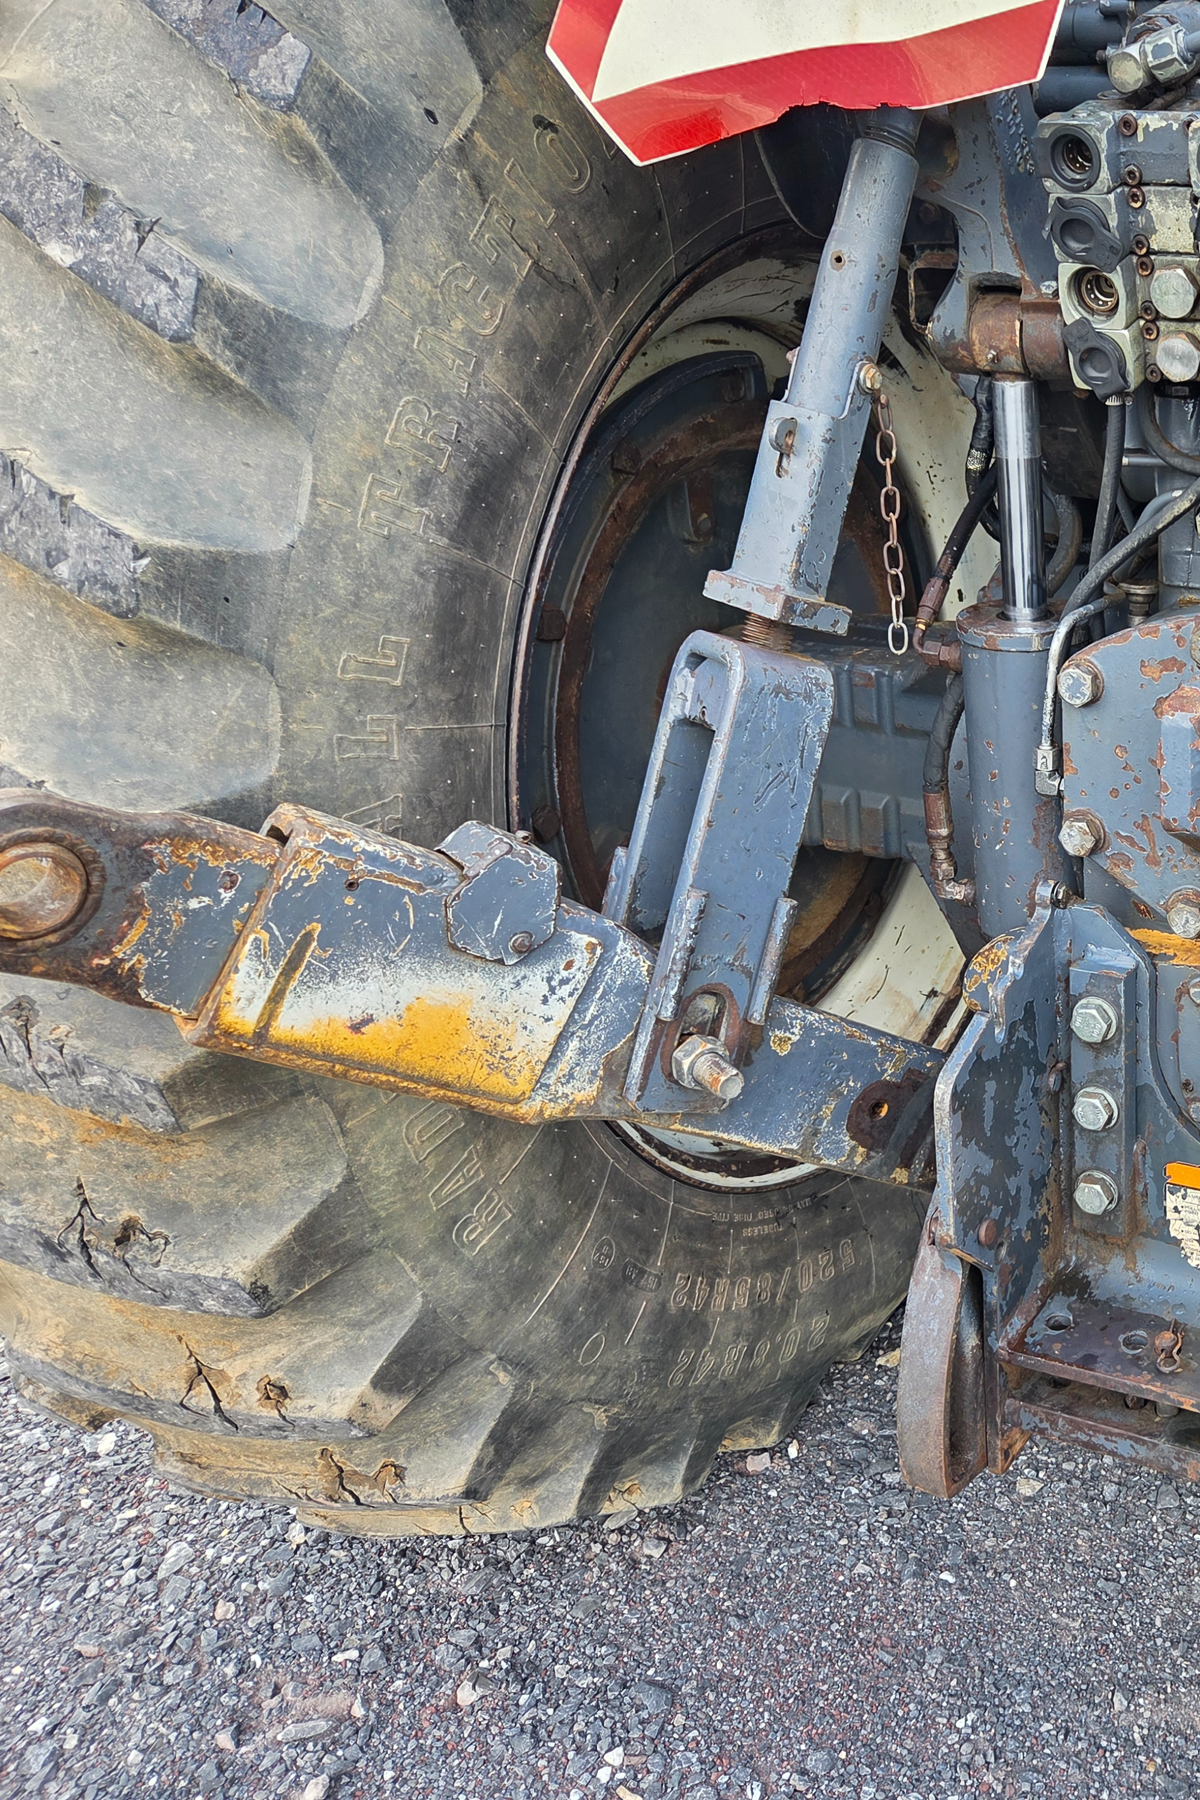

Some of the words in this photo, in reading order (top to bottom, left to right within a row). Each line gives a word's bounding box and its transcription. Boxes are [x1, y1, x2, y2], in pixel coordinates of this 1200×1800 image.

[357, 96, 619, 541] TRACTIO
[381, 1092, 514, 1257] RAD
[670, 1239, 856, 1312] 520/85R42
[667, 1314, 830, 1388] 20.8R42
